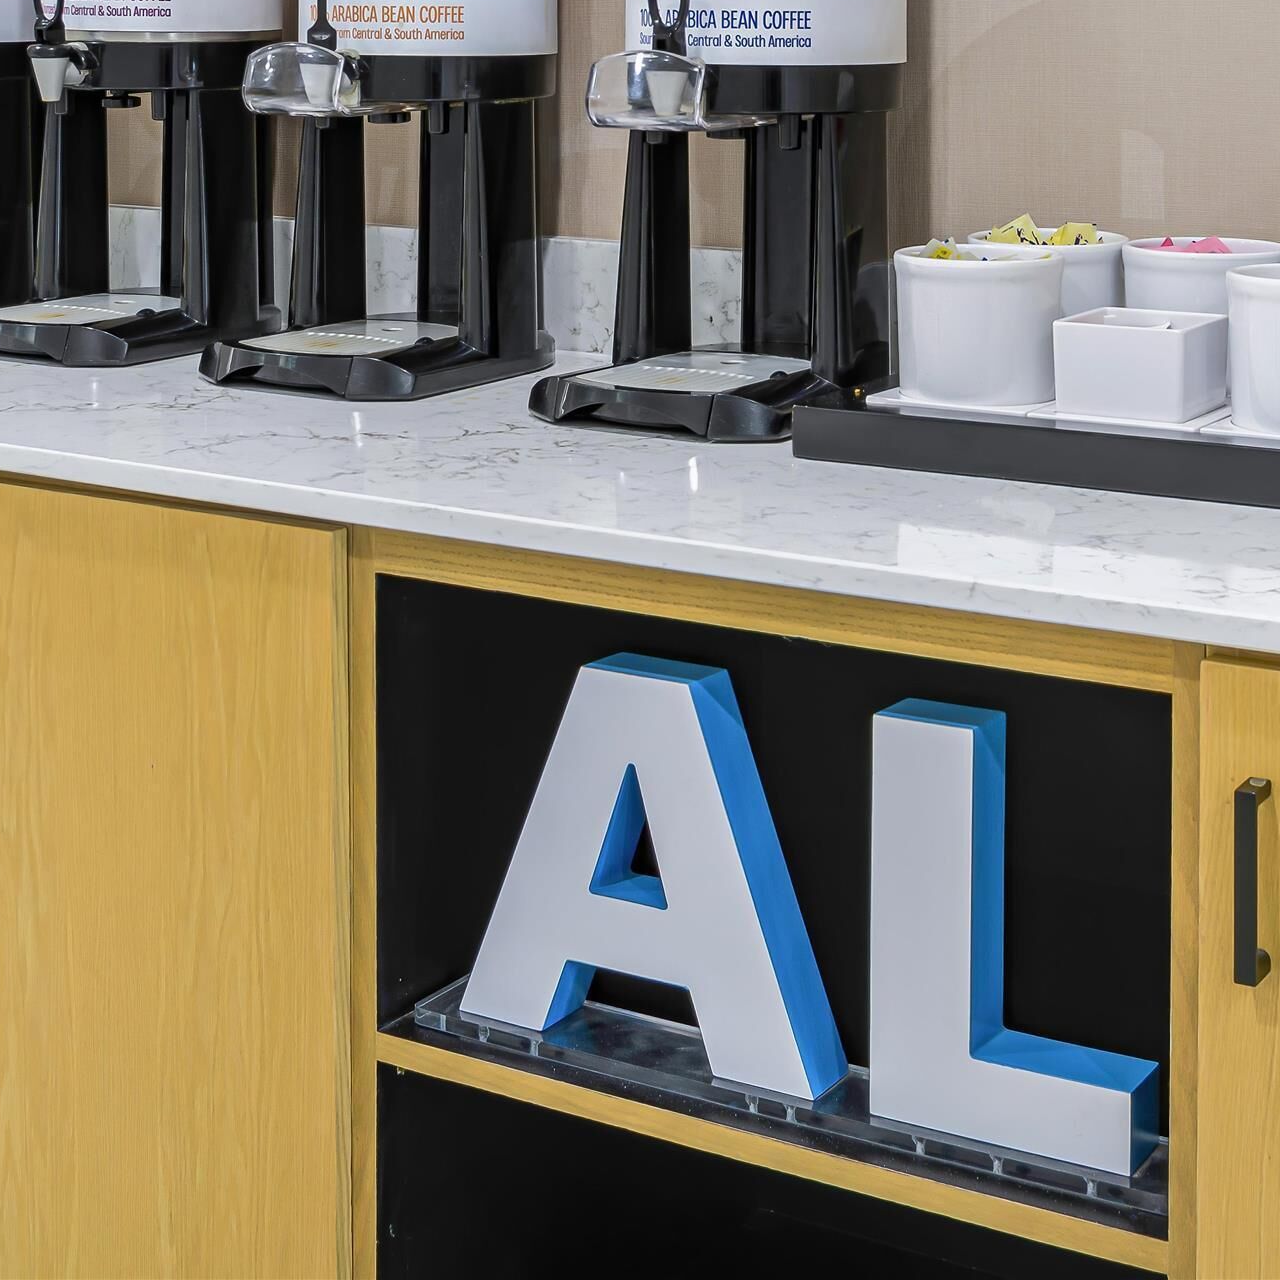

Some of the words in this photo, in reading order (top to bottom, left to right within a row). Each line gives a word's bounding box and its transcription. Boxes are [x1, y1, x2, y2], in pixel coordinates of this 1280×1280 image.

[70, 4, 97, 17] Central
[98, 5, 105, 17] &
[106, 5, 132, 17] South
[133, 6, 172, 18] America
[332, 4, 378, 23] ARABICA
[381, 5, 415, 23] BEAN
[419, 5, 465, 24] COFFEE
[666, 10, 717, 29] ARBICA
[721, 10, 758, 30] BEAN
[763, 10, 812, 31] COFFEE
[337, 29, 351, 40] rom
[352, 27, 382, 40] Central
[384, 28, 392, 40] &
[394, 28, 423, 40] South
[424, 28, 465, 41] America
[688, 34, 722, 47] Central
[724, 35, 733, 47] &
[735, 35, 766, 48] South
[768, 35, 812, 48] America
